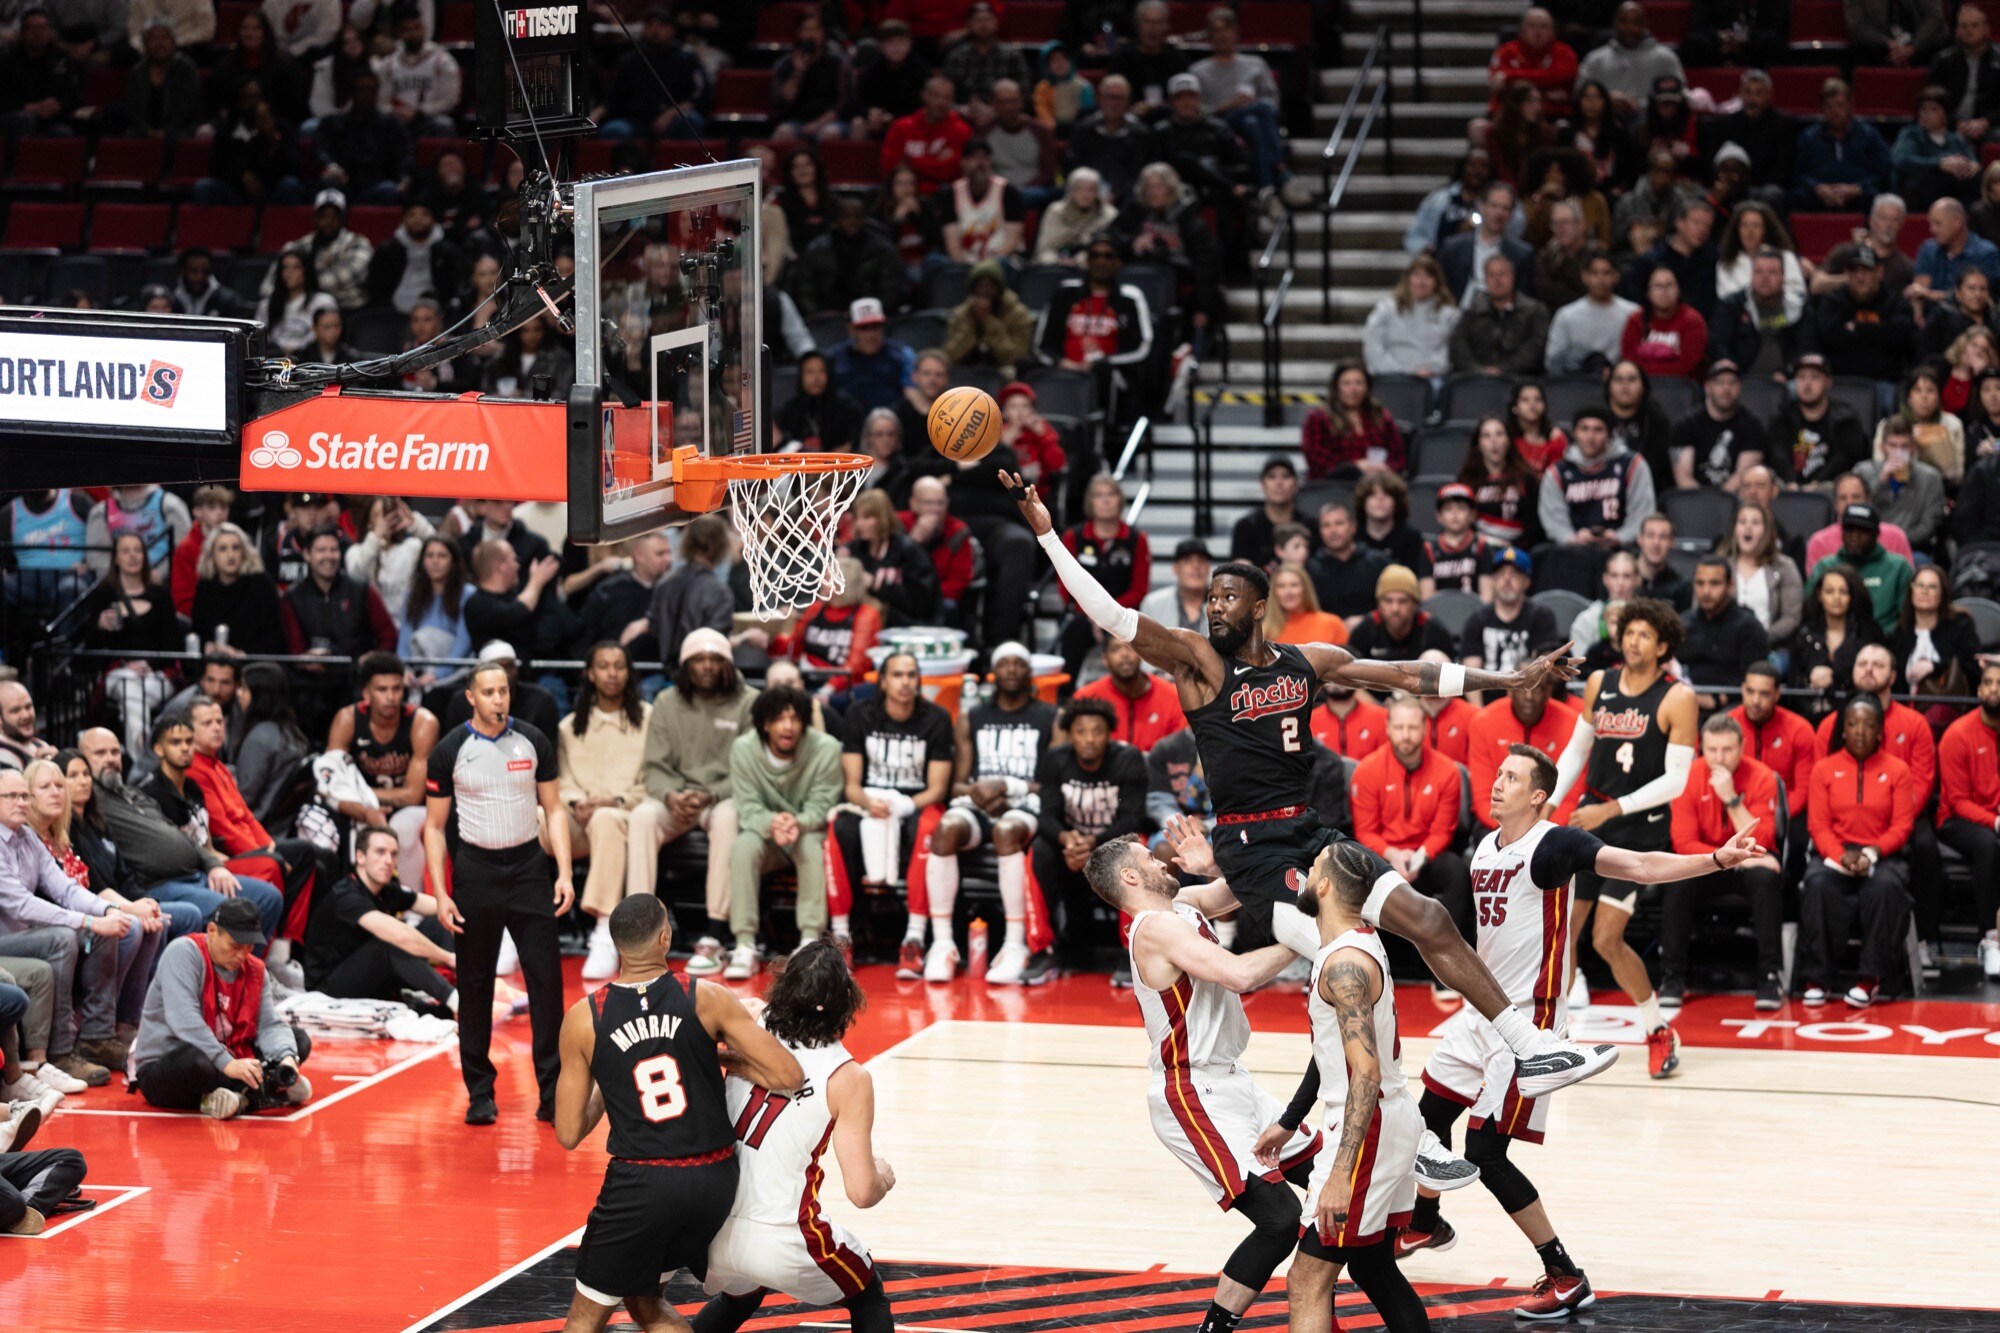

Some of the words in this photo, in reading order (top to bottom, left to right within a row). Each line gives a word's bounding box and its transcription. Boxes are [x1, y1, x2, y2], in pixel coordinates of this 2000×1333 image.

[526, 5, 578, 37] TISSOT
[951, 408, 986, 453] Wilson
[1230, 675, 1309, 723] ripcity
[1281, 716, 1301, 753] 2
[1615, 741, 1635, 774] 4
[1479, 896, 1509, 927] 55
[609, 1013, 683, 1053] MURRAY
[1720, 1018, 2000, 1046] TOY
[631, 1052, 689, 1124] 8
[734, 1083, 792, 1151] 11
